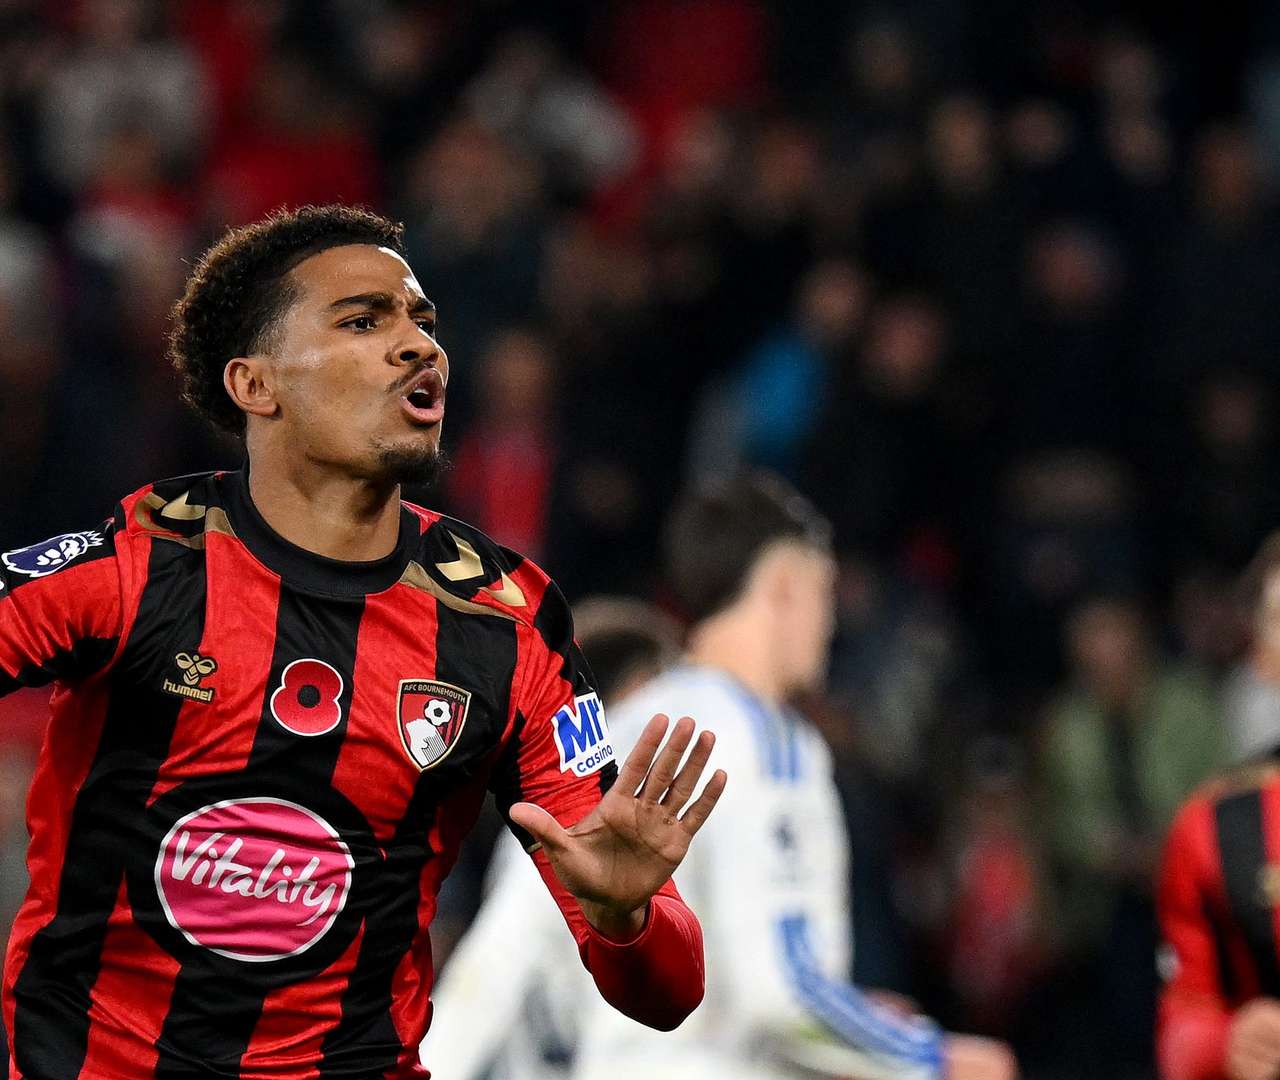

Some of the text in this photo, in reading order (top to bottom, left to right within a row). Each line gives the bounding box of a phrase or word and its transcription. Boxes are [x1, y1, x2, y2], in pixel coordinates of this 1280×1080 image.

[162, 678, 213, 702] hummel
[403, 683, 466, 704] AFC BOURNEMOUTH
[576, 744, 614, 774] casino
[171, 830, 337, 927] Vitality
